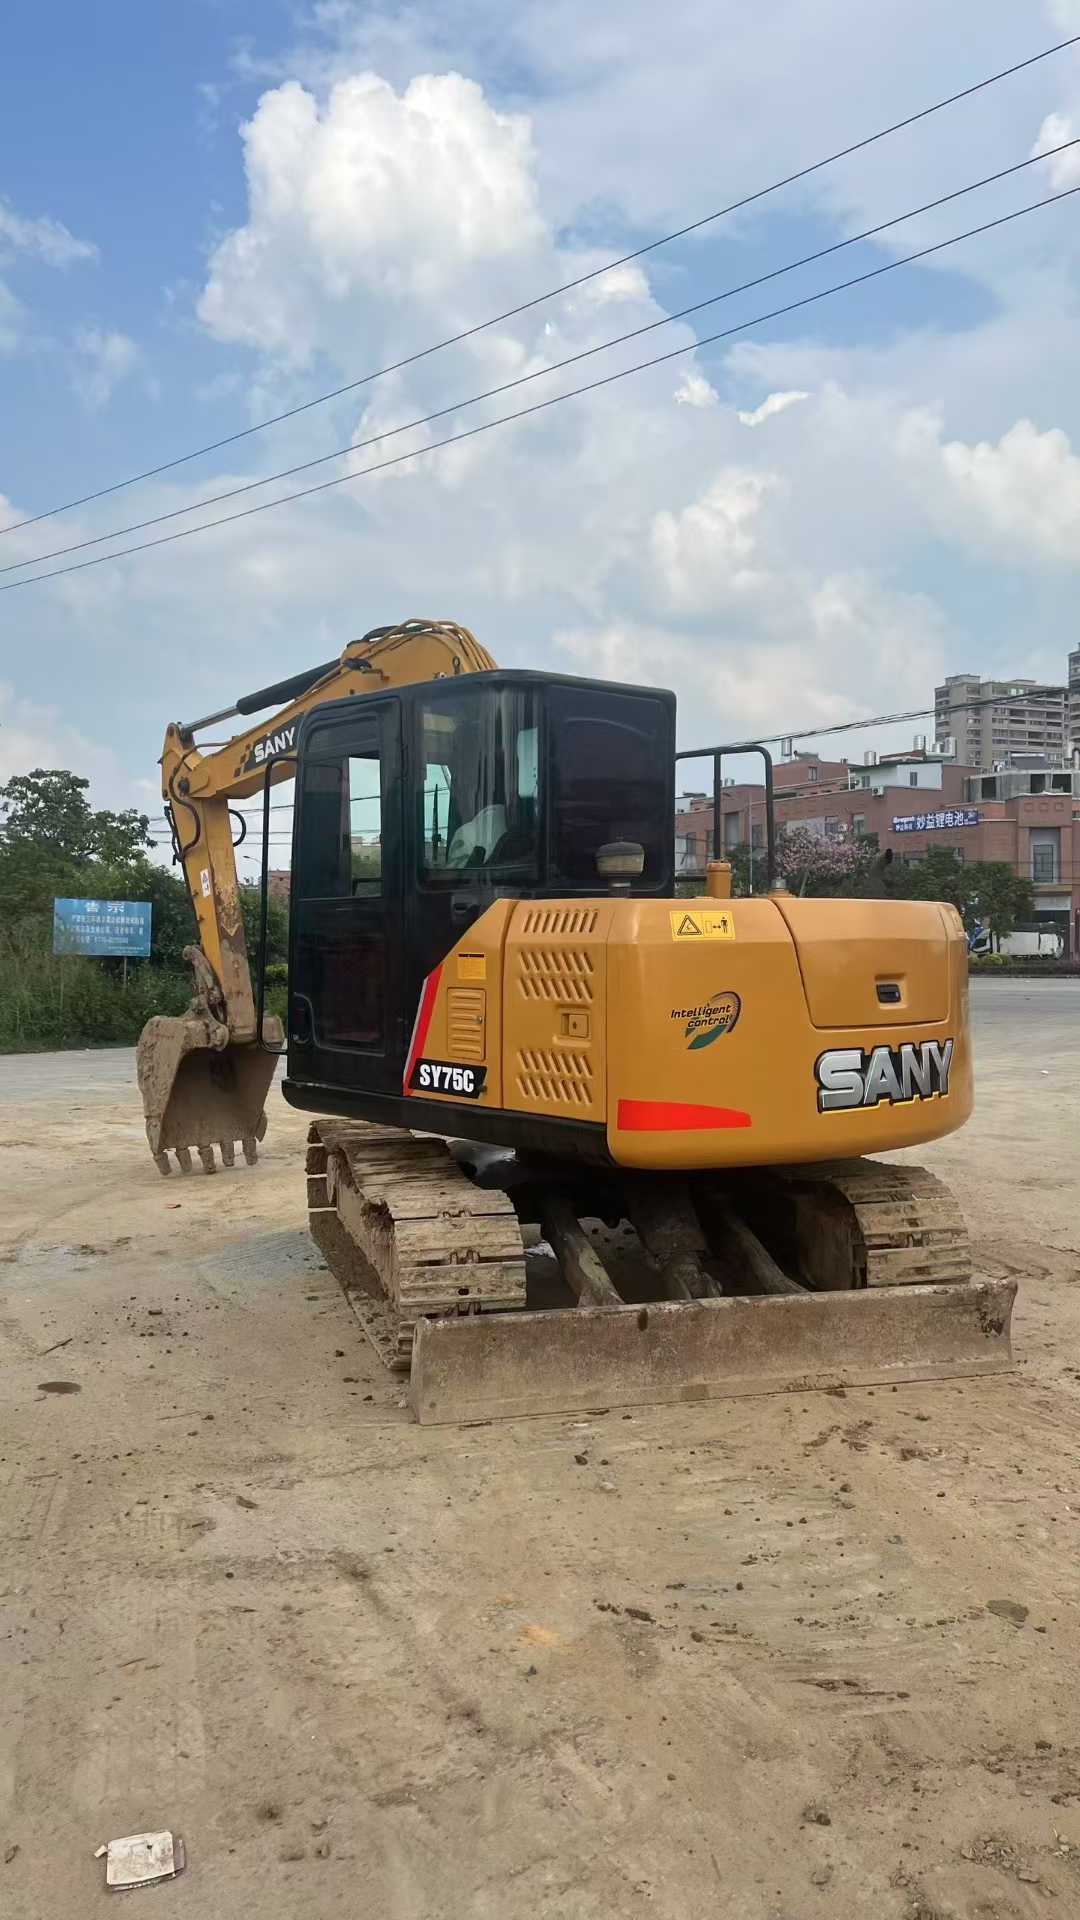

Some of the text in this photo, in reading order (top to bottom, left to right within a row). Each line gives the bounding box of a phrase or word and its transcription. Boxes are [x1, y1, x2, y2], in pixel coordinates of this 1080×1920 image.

[255, 727, 295, 763] SANY
[671, 1003, 731, 1018] Intelligent
[687, 1014, 730, 1028] control
[419, 1064, 475, 1093] SY75C
[815, 1039, 954, 1112] SANY
